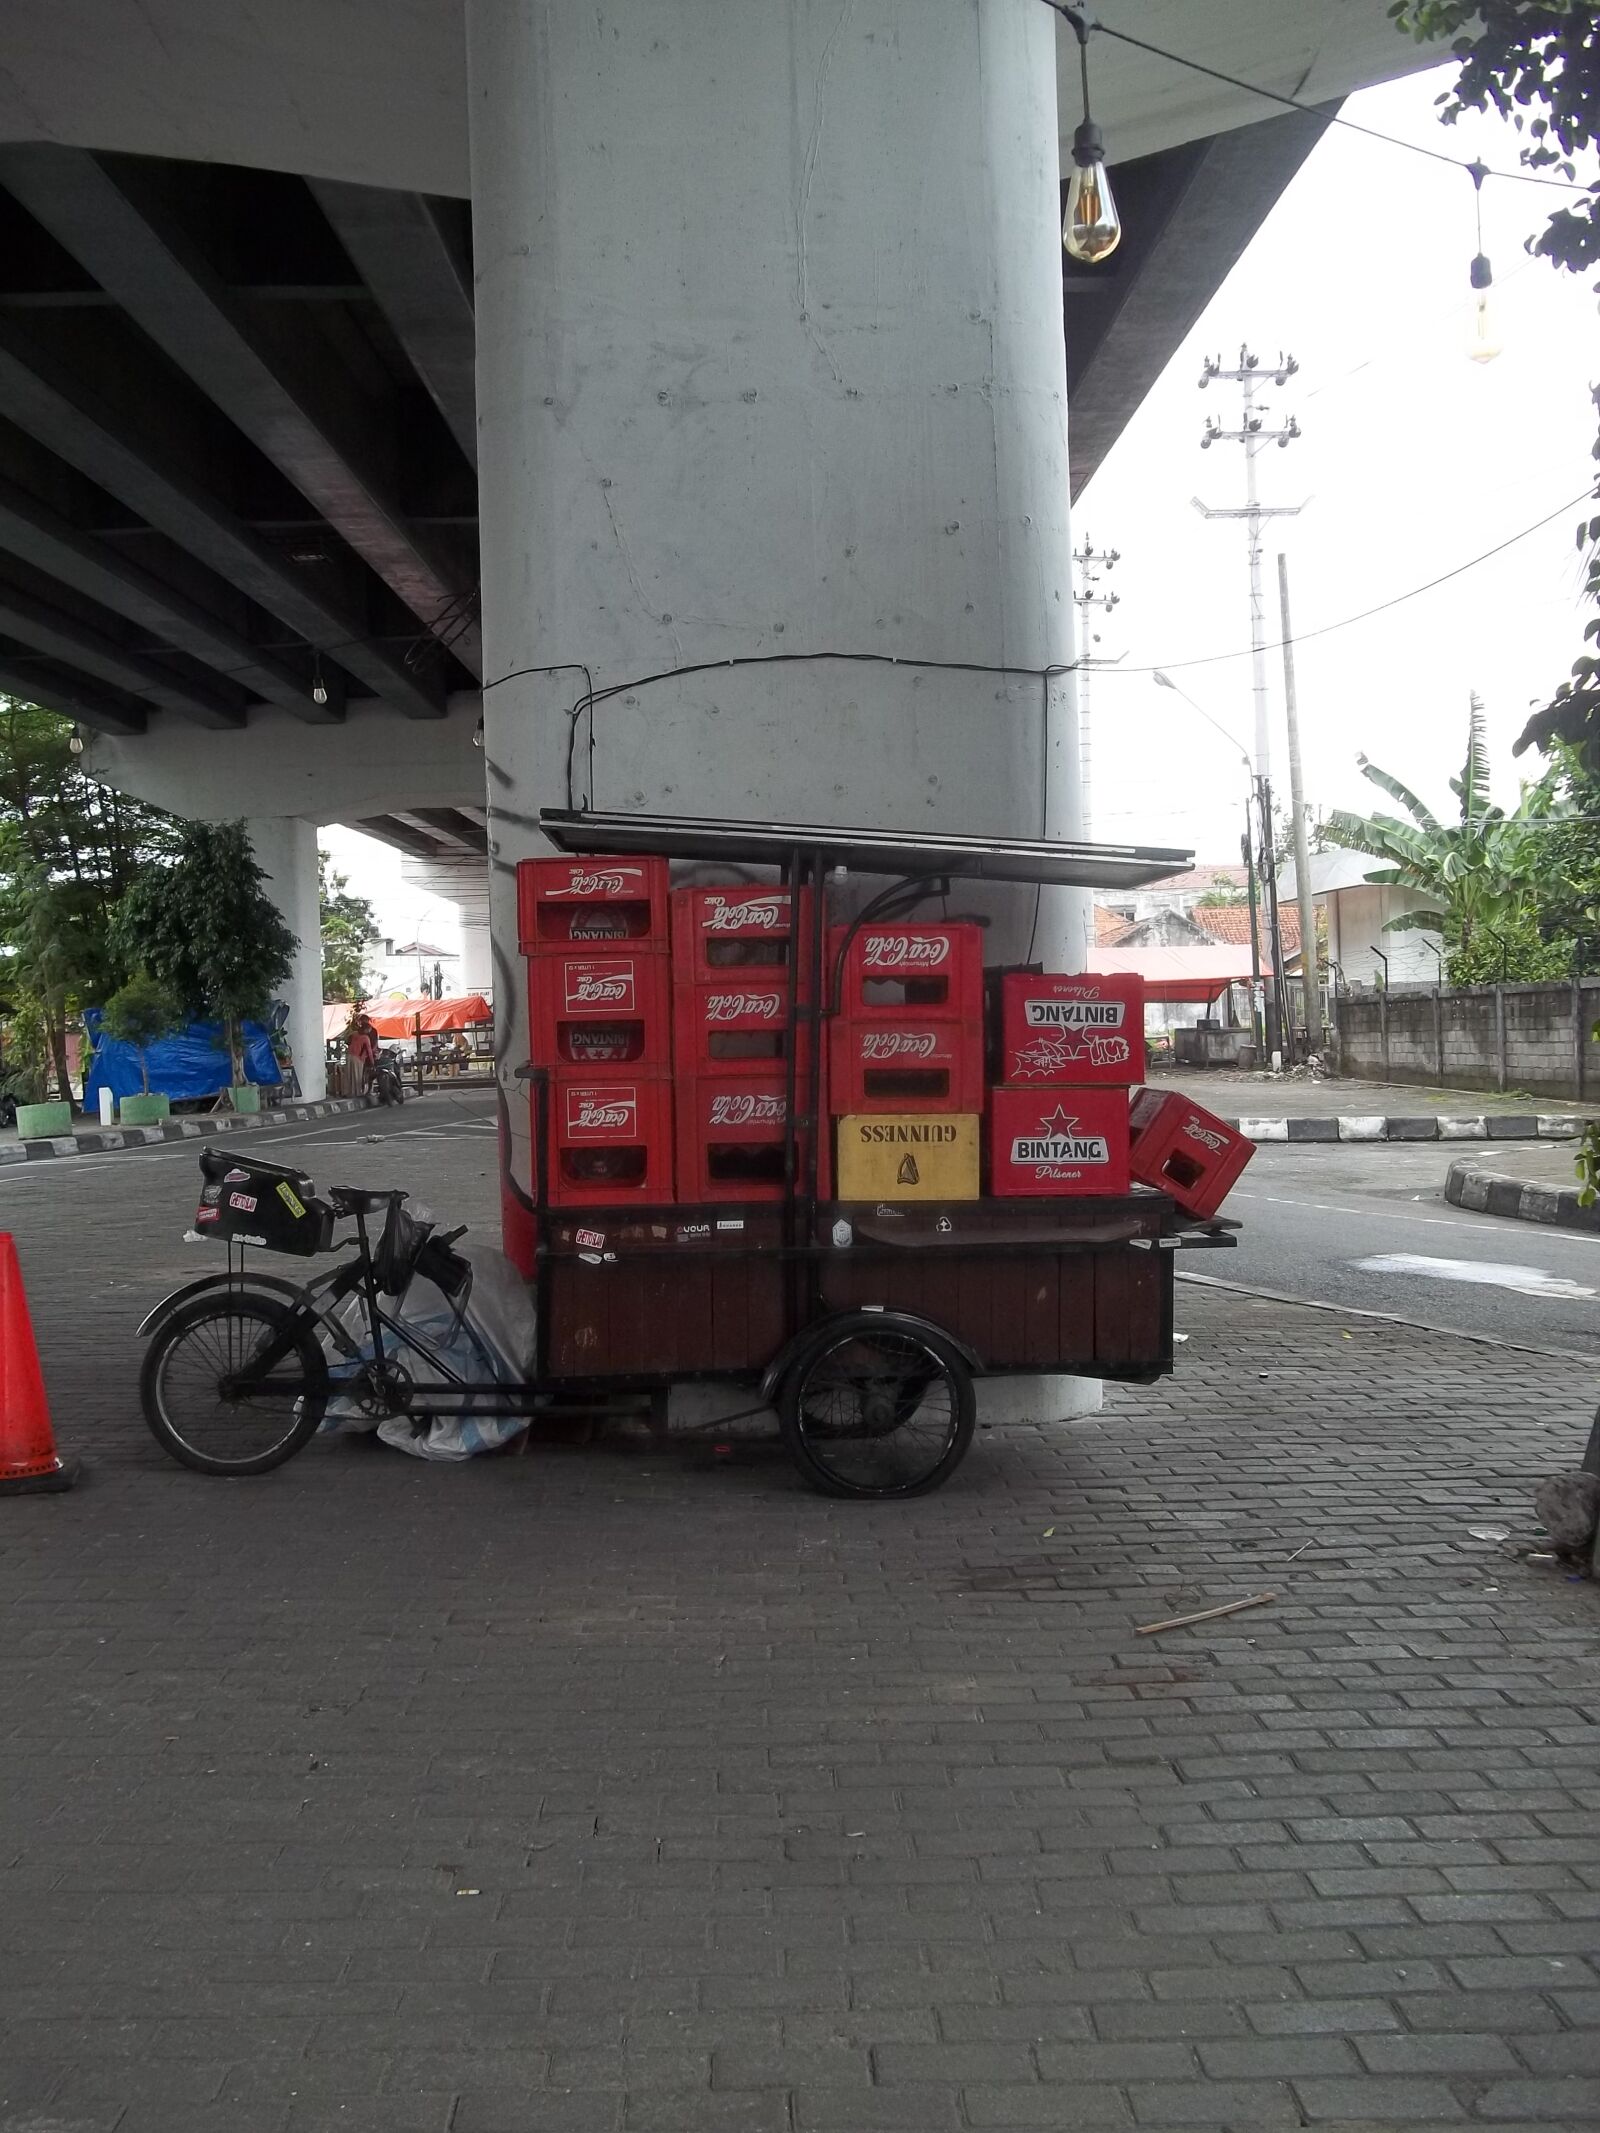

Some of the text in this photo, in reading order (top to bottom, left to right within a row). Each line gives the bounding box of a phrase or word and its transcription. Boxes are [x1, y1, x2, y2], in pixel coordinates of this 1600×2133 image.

[711, 904, 779, 930] Coca-Cola
[862, 936, 950, 967] Coca-Cola
[576, 982, 627, 1001] Coca-Cola
[1052, 984, 1100, 999] Pilsener
[704, 993, 780, 1020] Coca-Cola
[1032, 1004, 1118, 1024] BINTANG
[573, 1033, 625, 1045] BINTANG
[860, 1032, 936, 1059] Coca-Cola
[578, 1108, 629, 1128] Coca-Cola
[860, 1124, 957, 1143] GUINNESS
[1017, 1142, 1103, 1159] BINTANG
[1035, 1165, 1082, 1179] Pilsener
